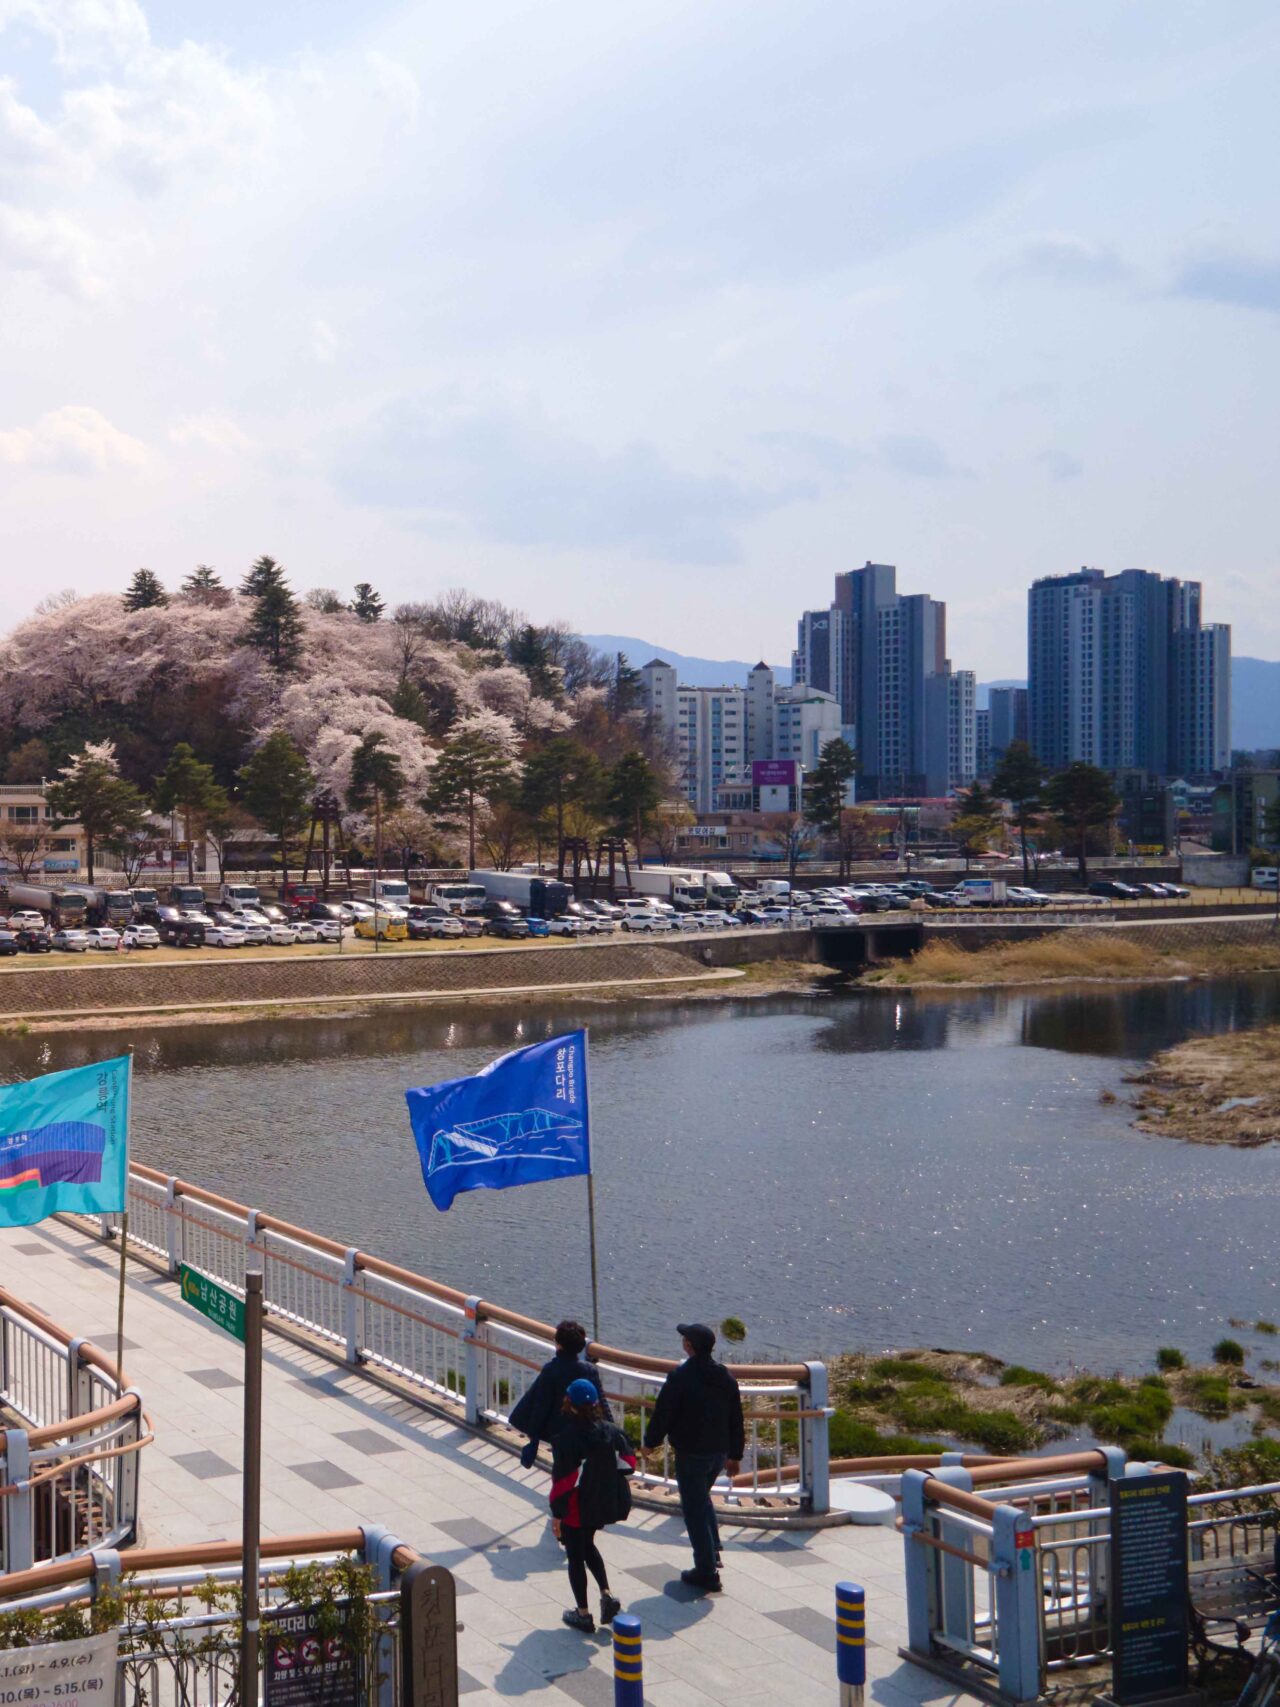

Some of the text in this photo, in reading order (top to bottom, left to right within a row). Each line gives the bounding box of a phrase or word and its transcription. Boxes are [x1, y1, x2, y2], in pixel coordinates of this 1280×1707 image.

[96, 1071, 108, 1113] 강릉역
[556, 1047, 567, 1100] 창포다리
[200, 1281, 238, 1321] 남산공원
[49, 1653, 93, 1670] 4.9.(수)
[54, 1677, 104, 1696] 5.15.(목)
